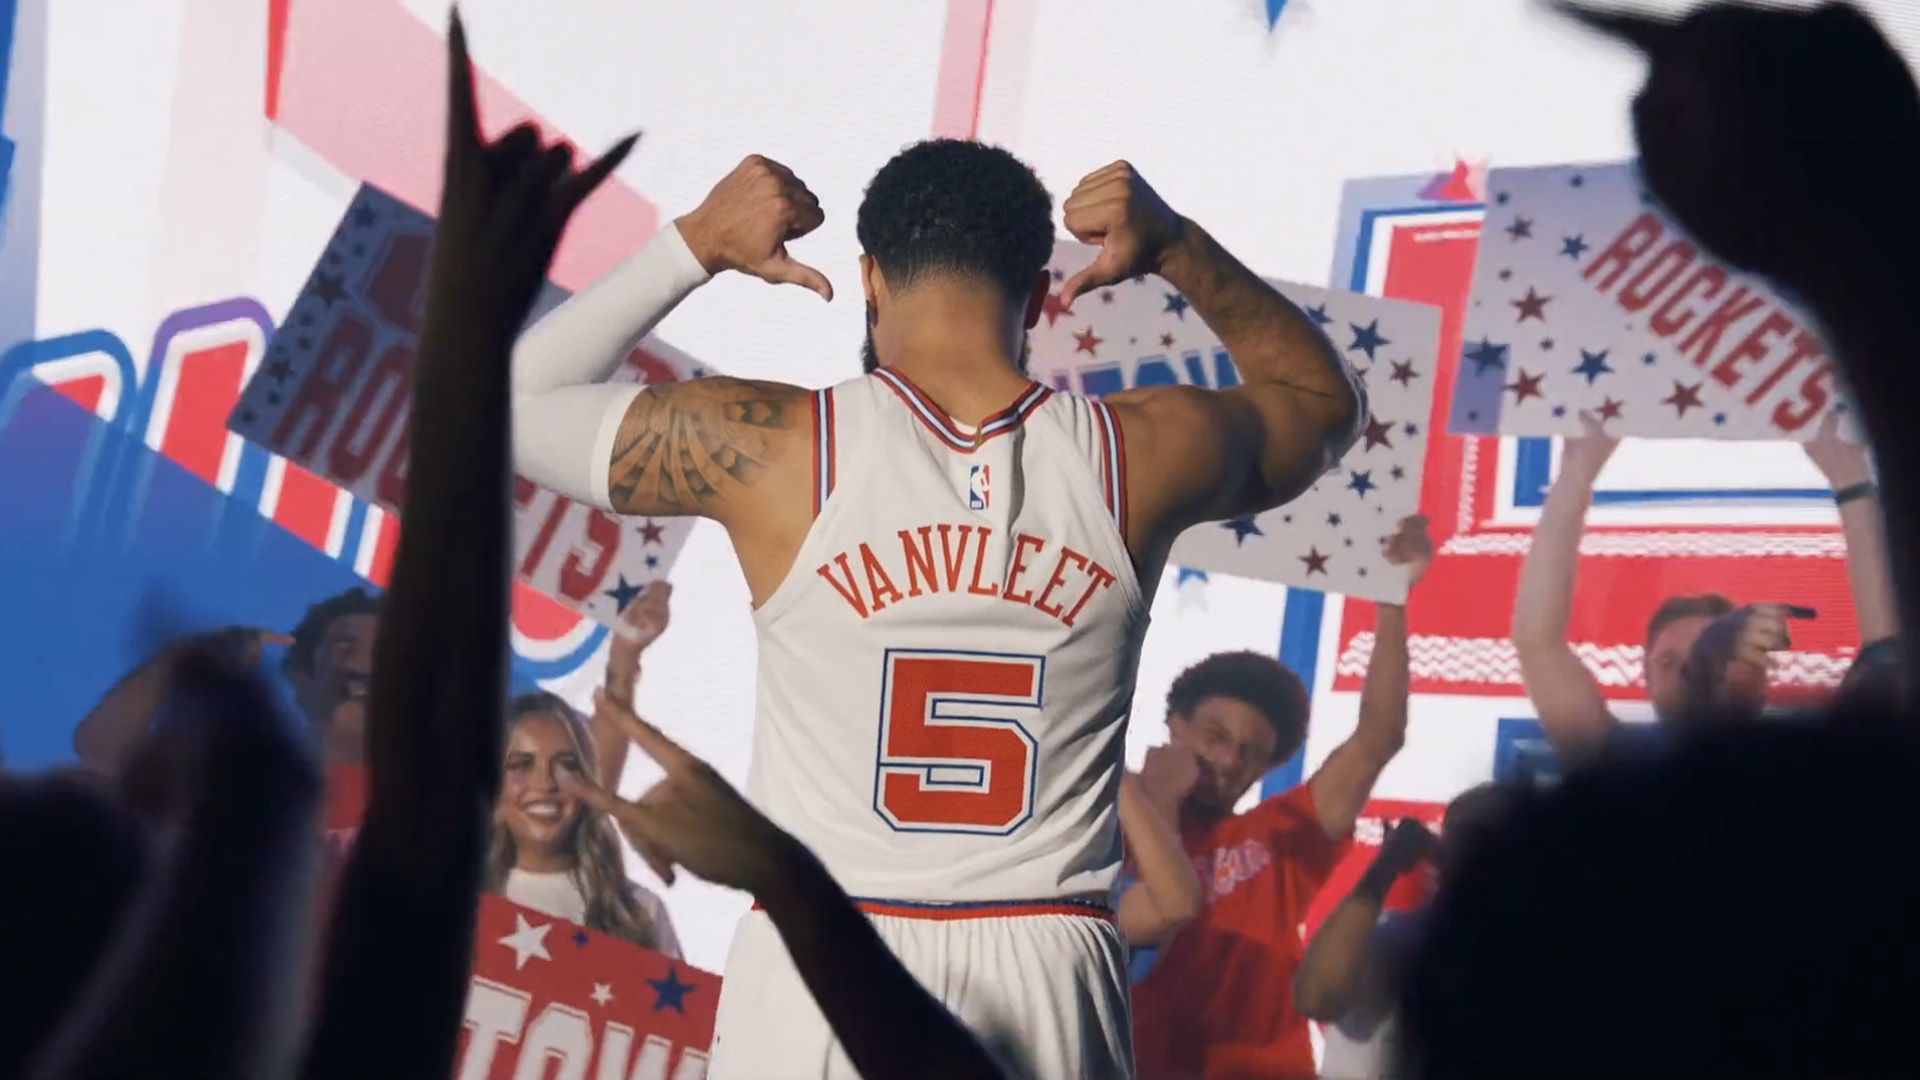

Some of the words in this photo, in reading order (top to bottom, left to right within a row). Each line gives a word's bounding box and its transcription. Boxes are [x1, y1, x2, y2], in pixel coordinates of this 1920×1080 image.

[1584, 213, 1836, 431] ROCKETS
[817, 524, 1116, 628] VANVLEET
[874, 648, 1046, 836] 5
